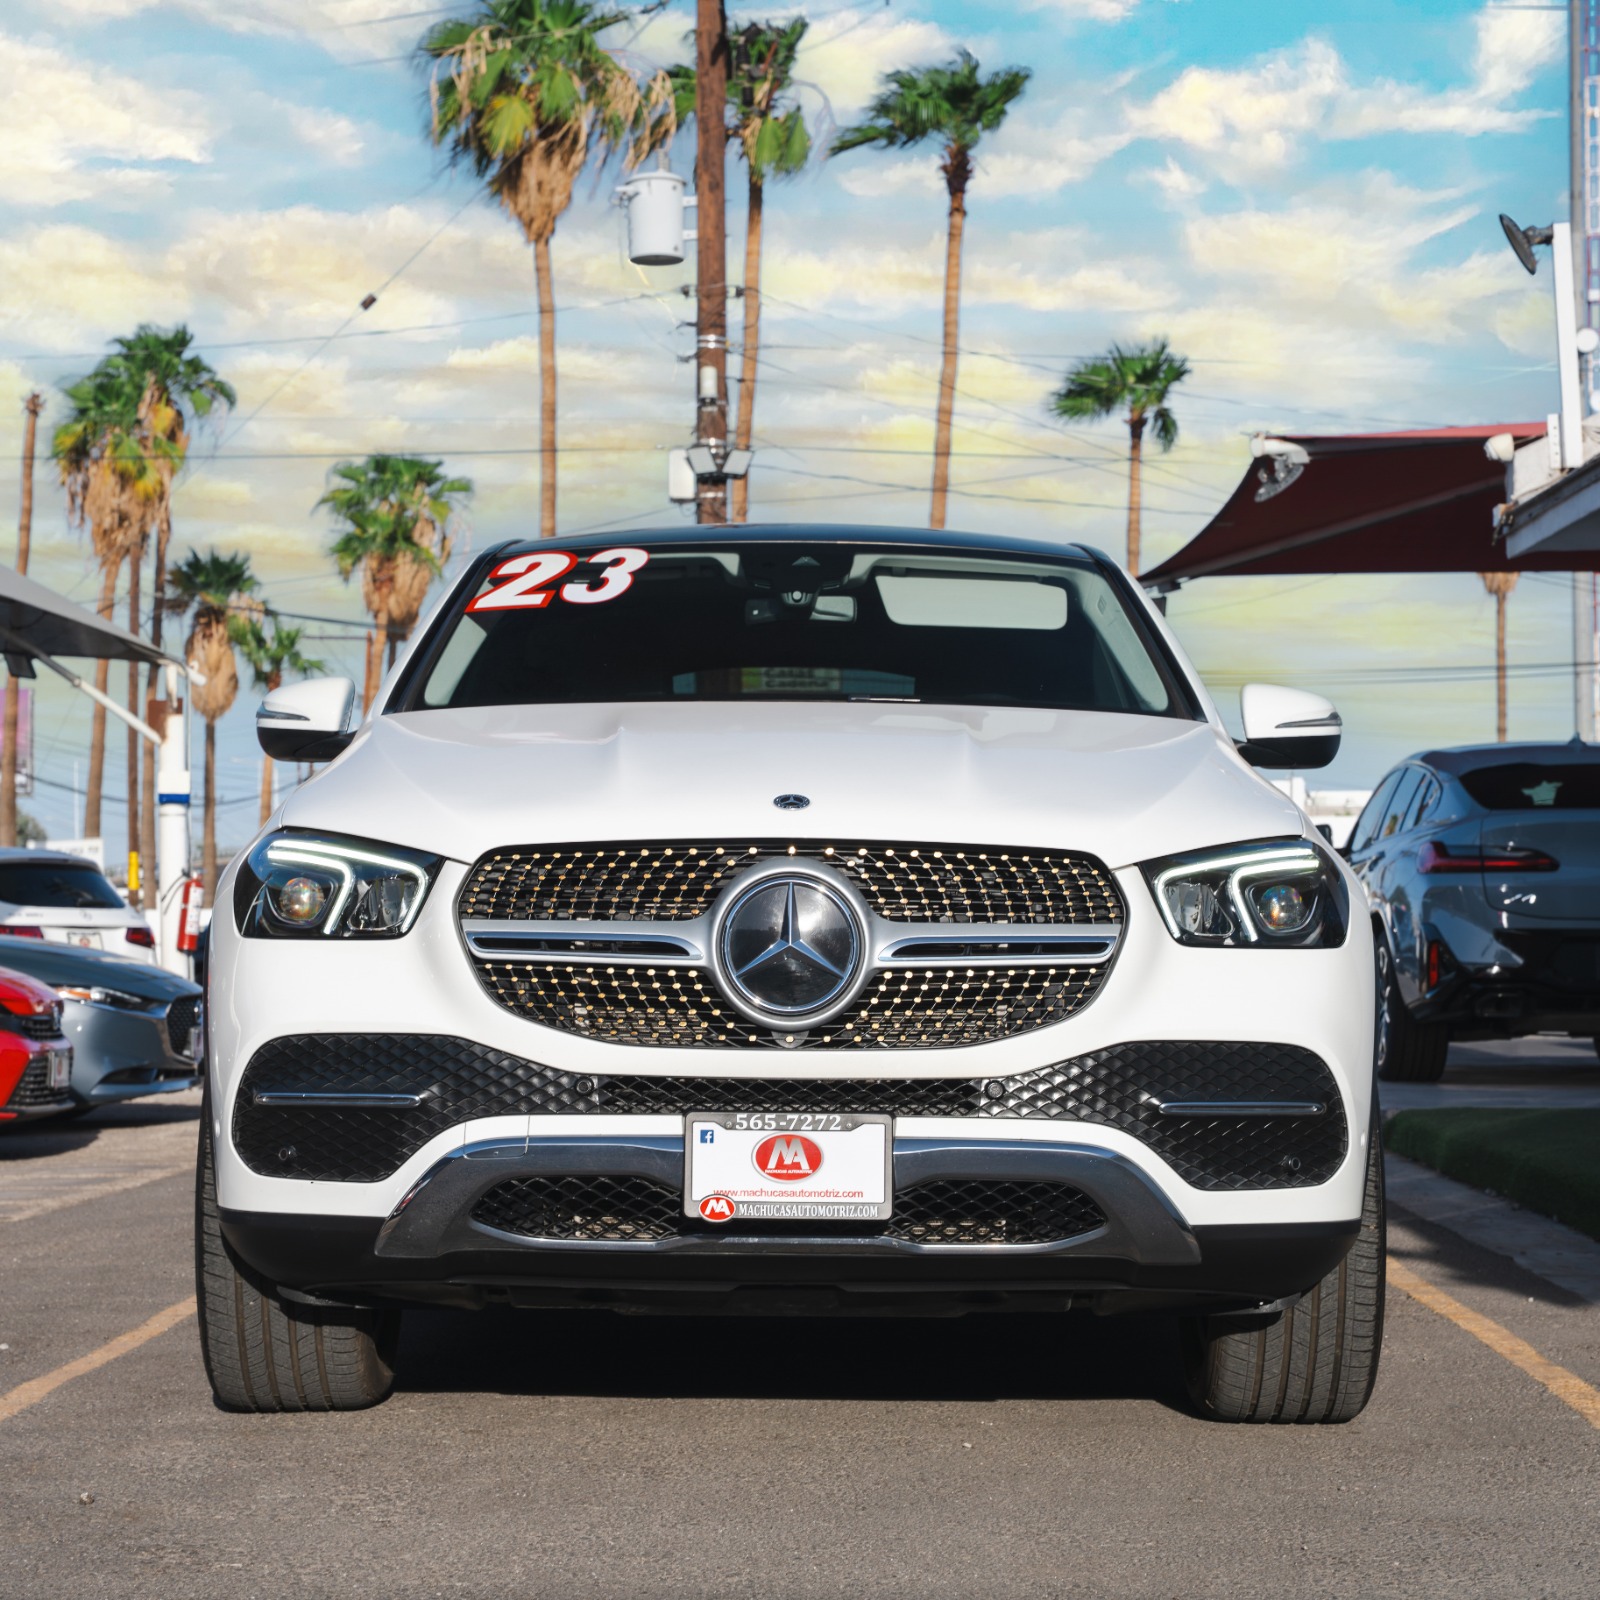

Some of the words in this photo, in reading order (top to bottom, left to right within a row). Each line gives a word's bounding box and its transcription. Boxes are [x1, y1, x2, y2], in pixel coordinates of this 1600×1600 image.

[464, 547, 650, 613] 23
[735, 1114, 842, 1131] 565-7272
[713, 1187, 864, 1198] www.machucasautomotriz.com
